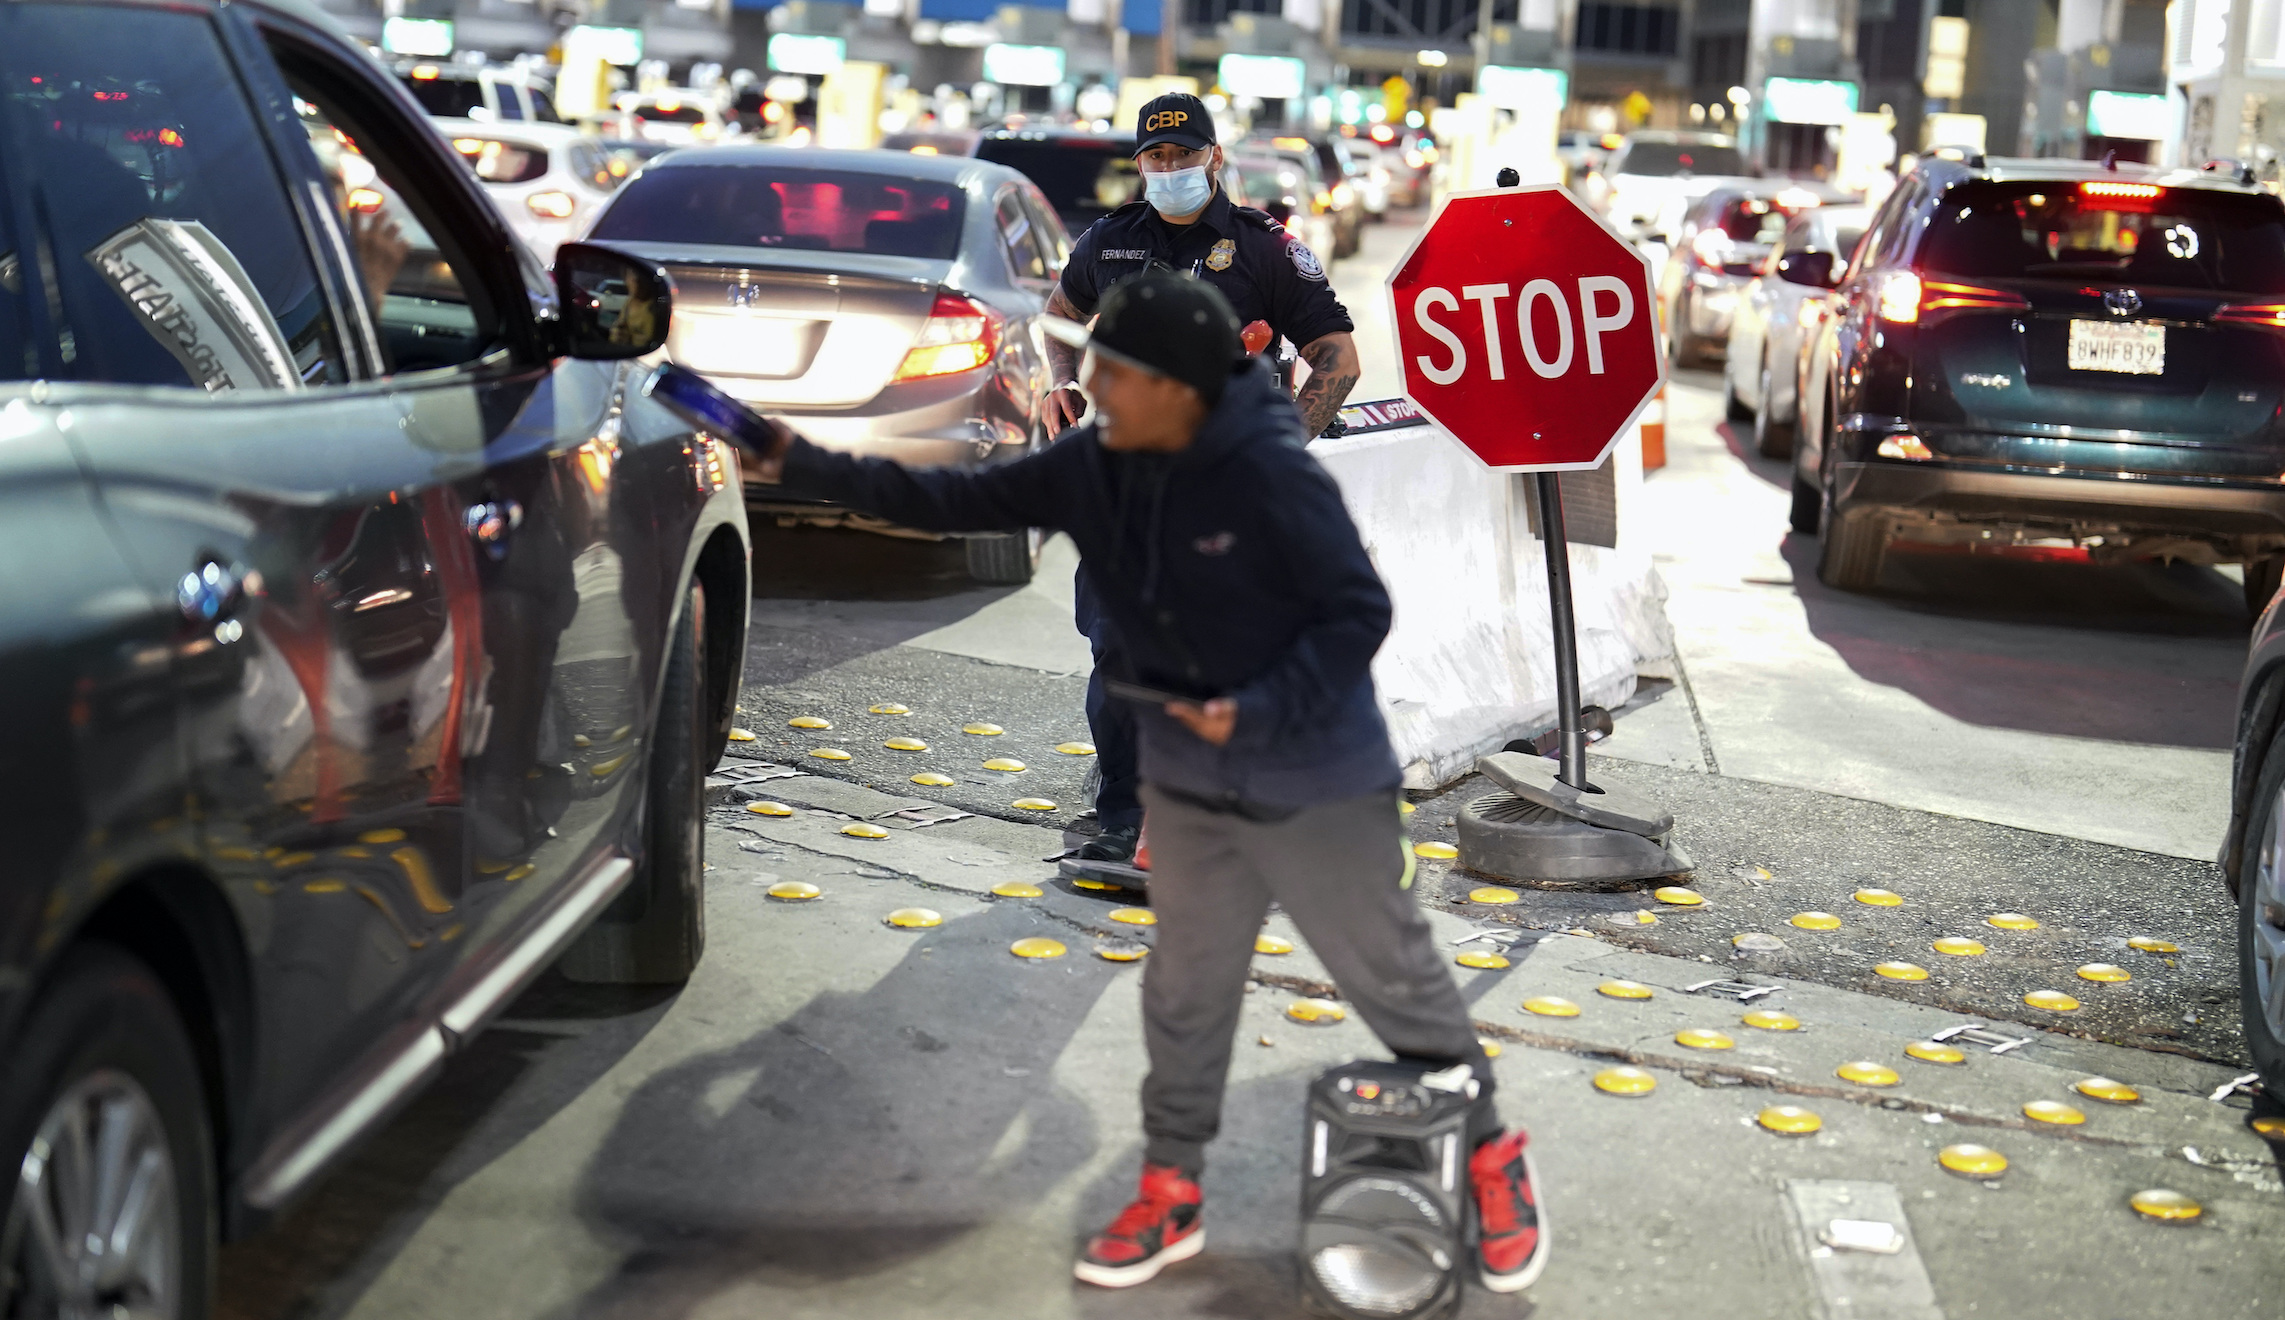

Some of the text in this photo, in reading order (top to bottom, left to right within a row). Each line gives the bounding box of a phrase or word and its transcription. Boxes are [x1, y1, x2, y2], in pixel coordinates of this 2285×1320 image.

[1146, 111, 1188, 132] CBP
[1101, 249, 1146, 260] FERNANDEZ
[1414, 275, 1634, 385] STOP
[2078, 339, 2157, 361] 8WHF839
